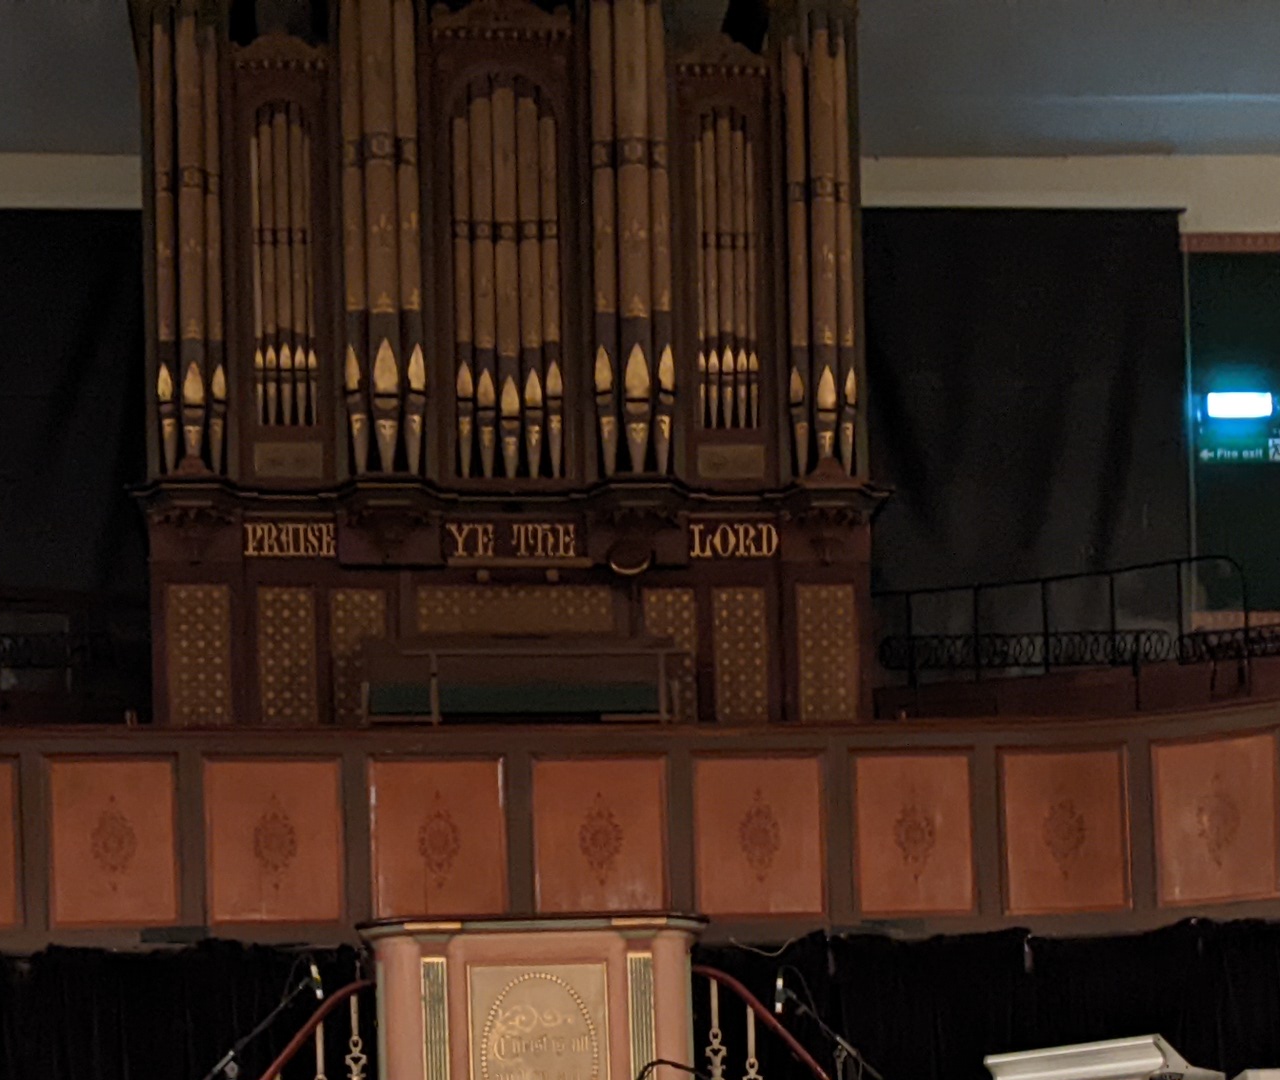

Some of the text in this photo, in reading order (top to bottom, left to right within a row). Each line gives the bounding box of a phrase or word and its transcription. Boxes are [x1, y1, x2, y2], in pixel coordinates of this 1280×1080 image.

[244, 523, 336, 556] PRAISE
[446, 523, 576, 557] YE THE
[689, 523, 779, 557] LORD
